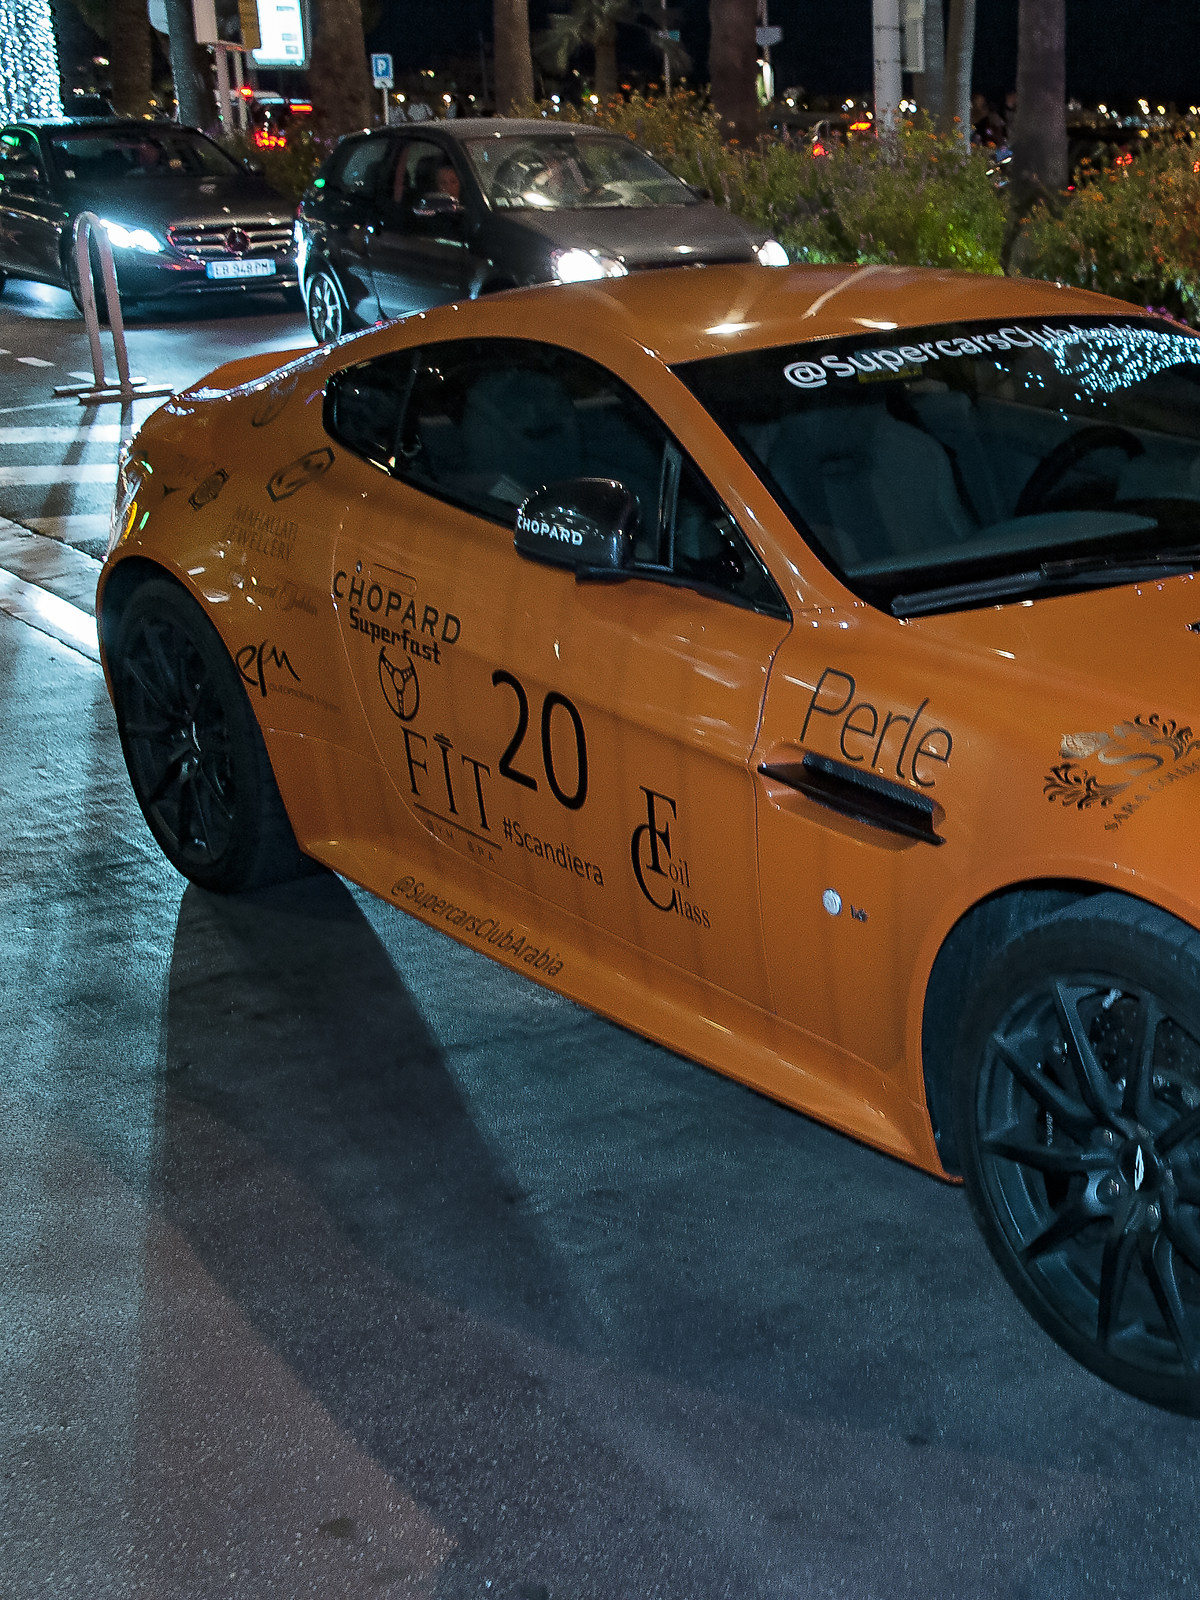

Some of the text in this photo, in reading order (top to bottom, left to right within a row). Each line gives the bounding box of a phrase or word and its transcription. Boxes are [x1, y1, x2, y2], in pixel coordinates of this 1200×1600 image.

[517, 515, 583, 546] CHOPARD
[333, 570, 461, 644] CHOPARD
[349, 606, 440, 665] Superfast
[491, 669, 589, 811] 20
[800, 667, 953, 787] Perle
[502, 816, 604, 887] #Scandiera
[390, 875, 564, 977] @SupercarsClubArabia
